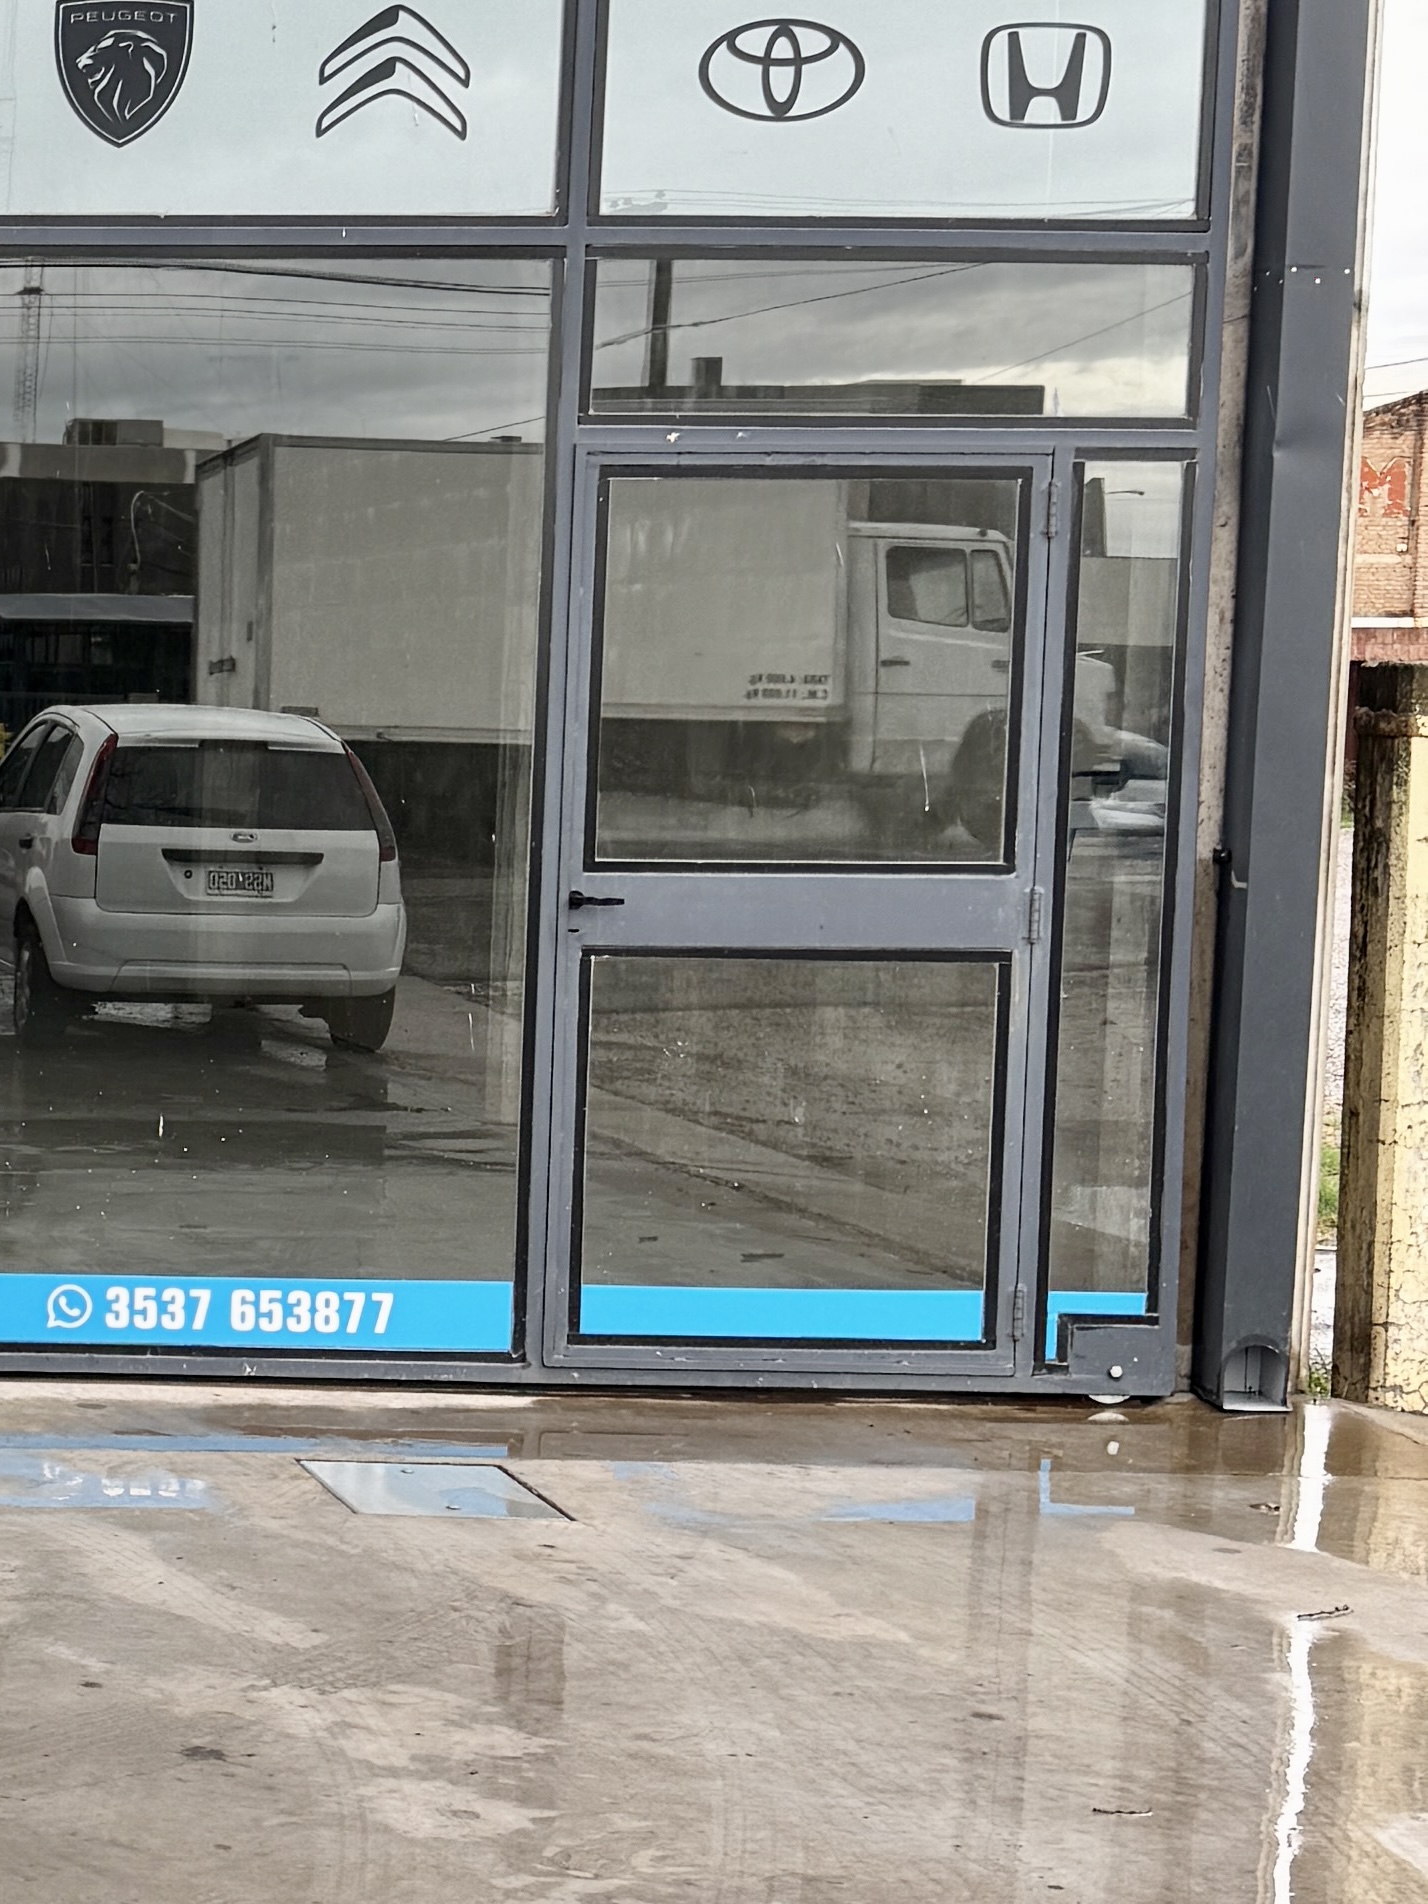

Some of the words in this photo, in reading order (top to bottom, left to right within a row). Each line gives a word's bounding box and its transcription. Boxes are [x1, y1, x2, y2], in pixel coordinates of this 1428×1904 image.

[70, 10, 179, 24] PEUGEOT
[105, 1286, 211, 1331] 3537
[230, 1289, 394, 1335] 653877
